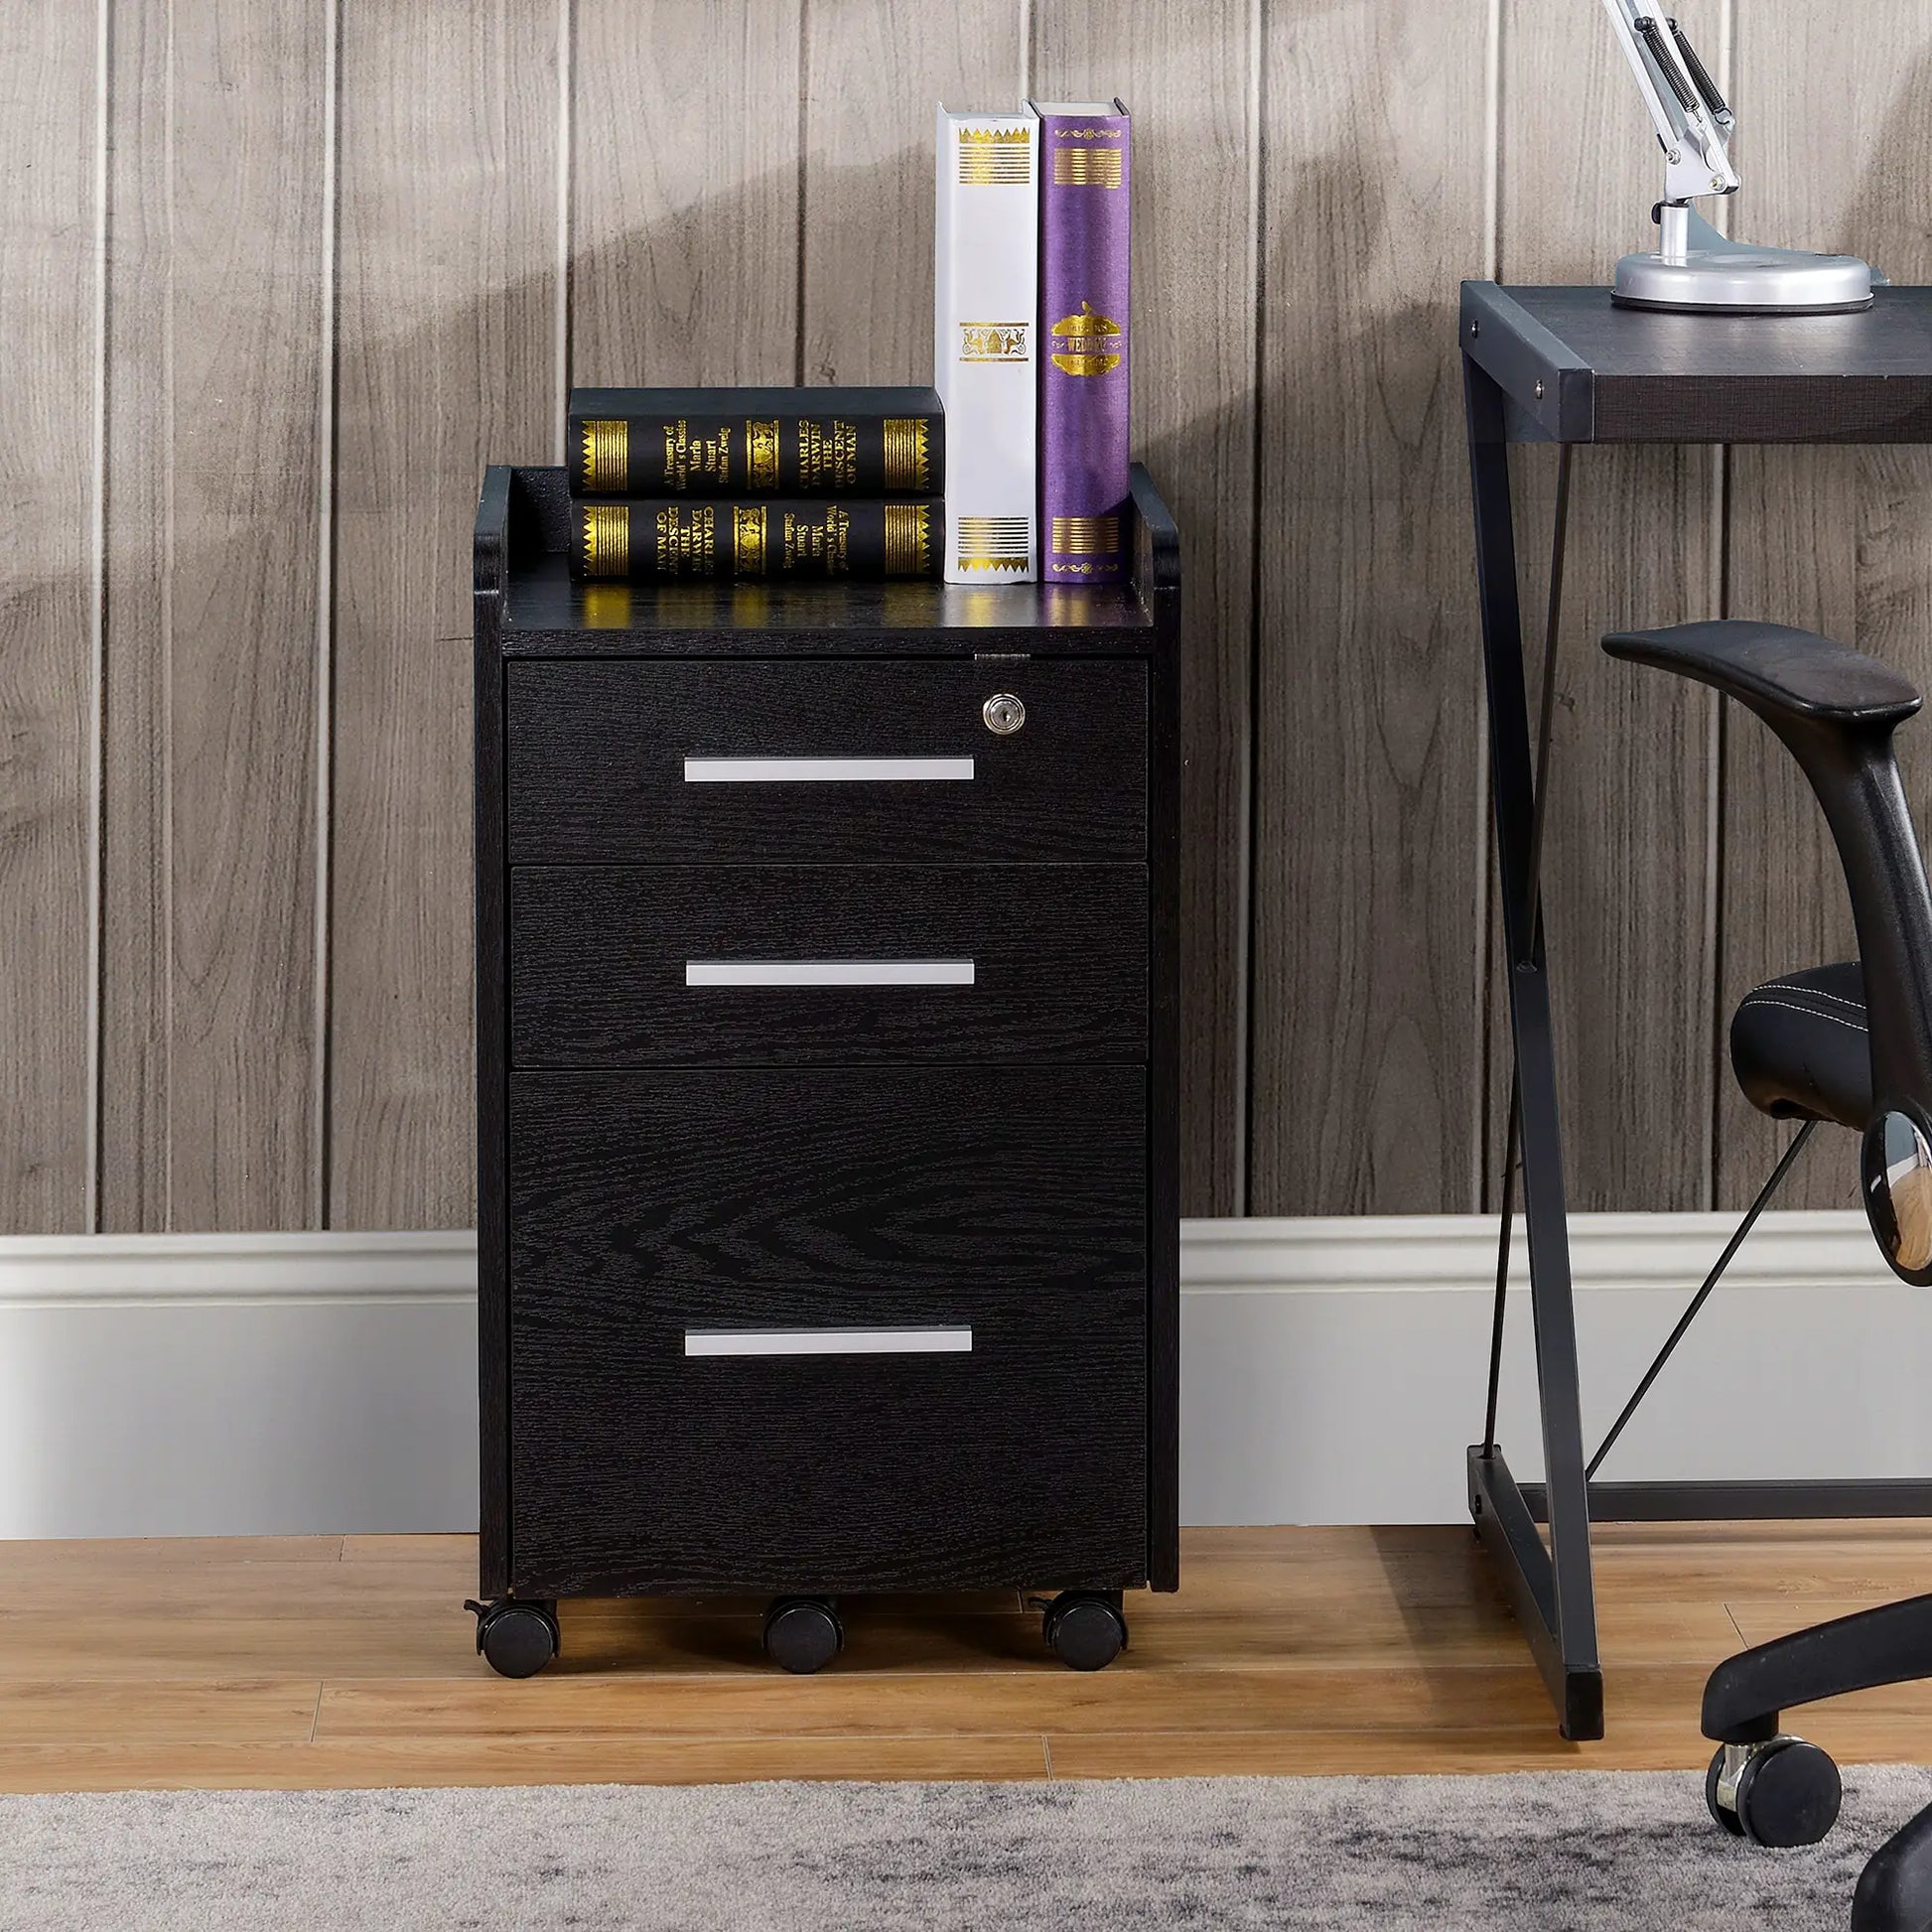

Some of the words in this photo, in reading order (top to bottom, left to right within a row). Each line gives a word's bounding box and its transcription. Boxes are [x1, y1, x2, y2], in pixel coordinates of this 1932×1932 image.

[704, 440, 716, 472] Stuart
[718, 427, 731, 454] Zweig
[799, 419, 809, 489] CHARLES
[811, 423, 821, 485] DARWIN
[823, 440, 832, 471] THE
[834, 420, 845, 488] DESCENT
[846, 425, 856, 461] MAN
[663, 438, 675, 477] Treasury
[847, 464, 856, 484] OF
[656, 511, 667, 533] OF
[656, 536, 667, 570] MAN
[680, 526, 690, 557] THE
[691, 509, 702, 572] DARWIN
[796, 525, 808, 557] Stuart
